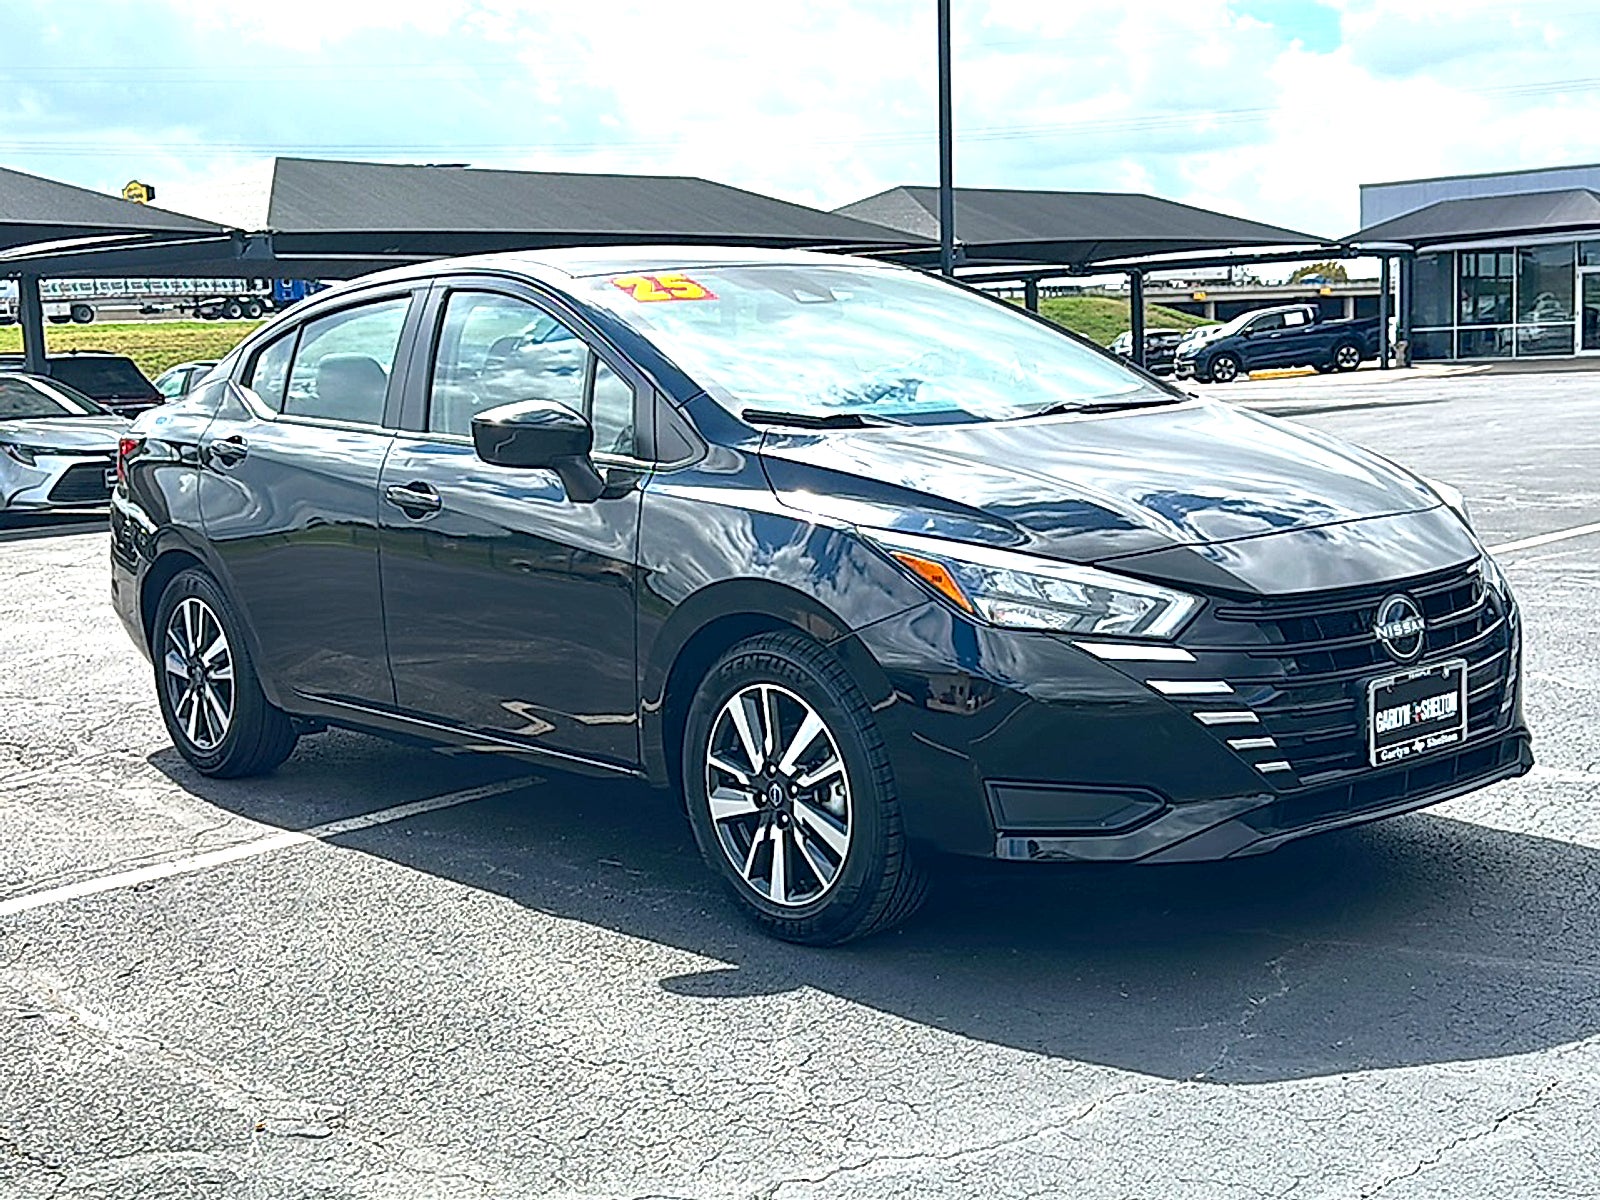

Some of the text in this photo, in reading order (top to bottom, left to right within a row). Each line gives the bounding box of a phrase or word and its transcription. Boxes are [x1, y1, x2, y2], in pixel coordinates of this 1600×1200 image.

[611, 273, 706, 301] 25
[1373, 617, 1425, 639] NISSAN
[720, 655, 816, 688] SENTURY
